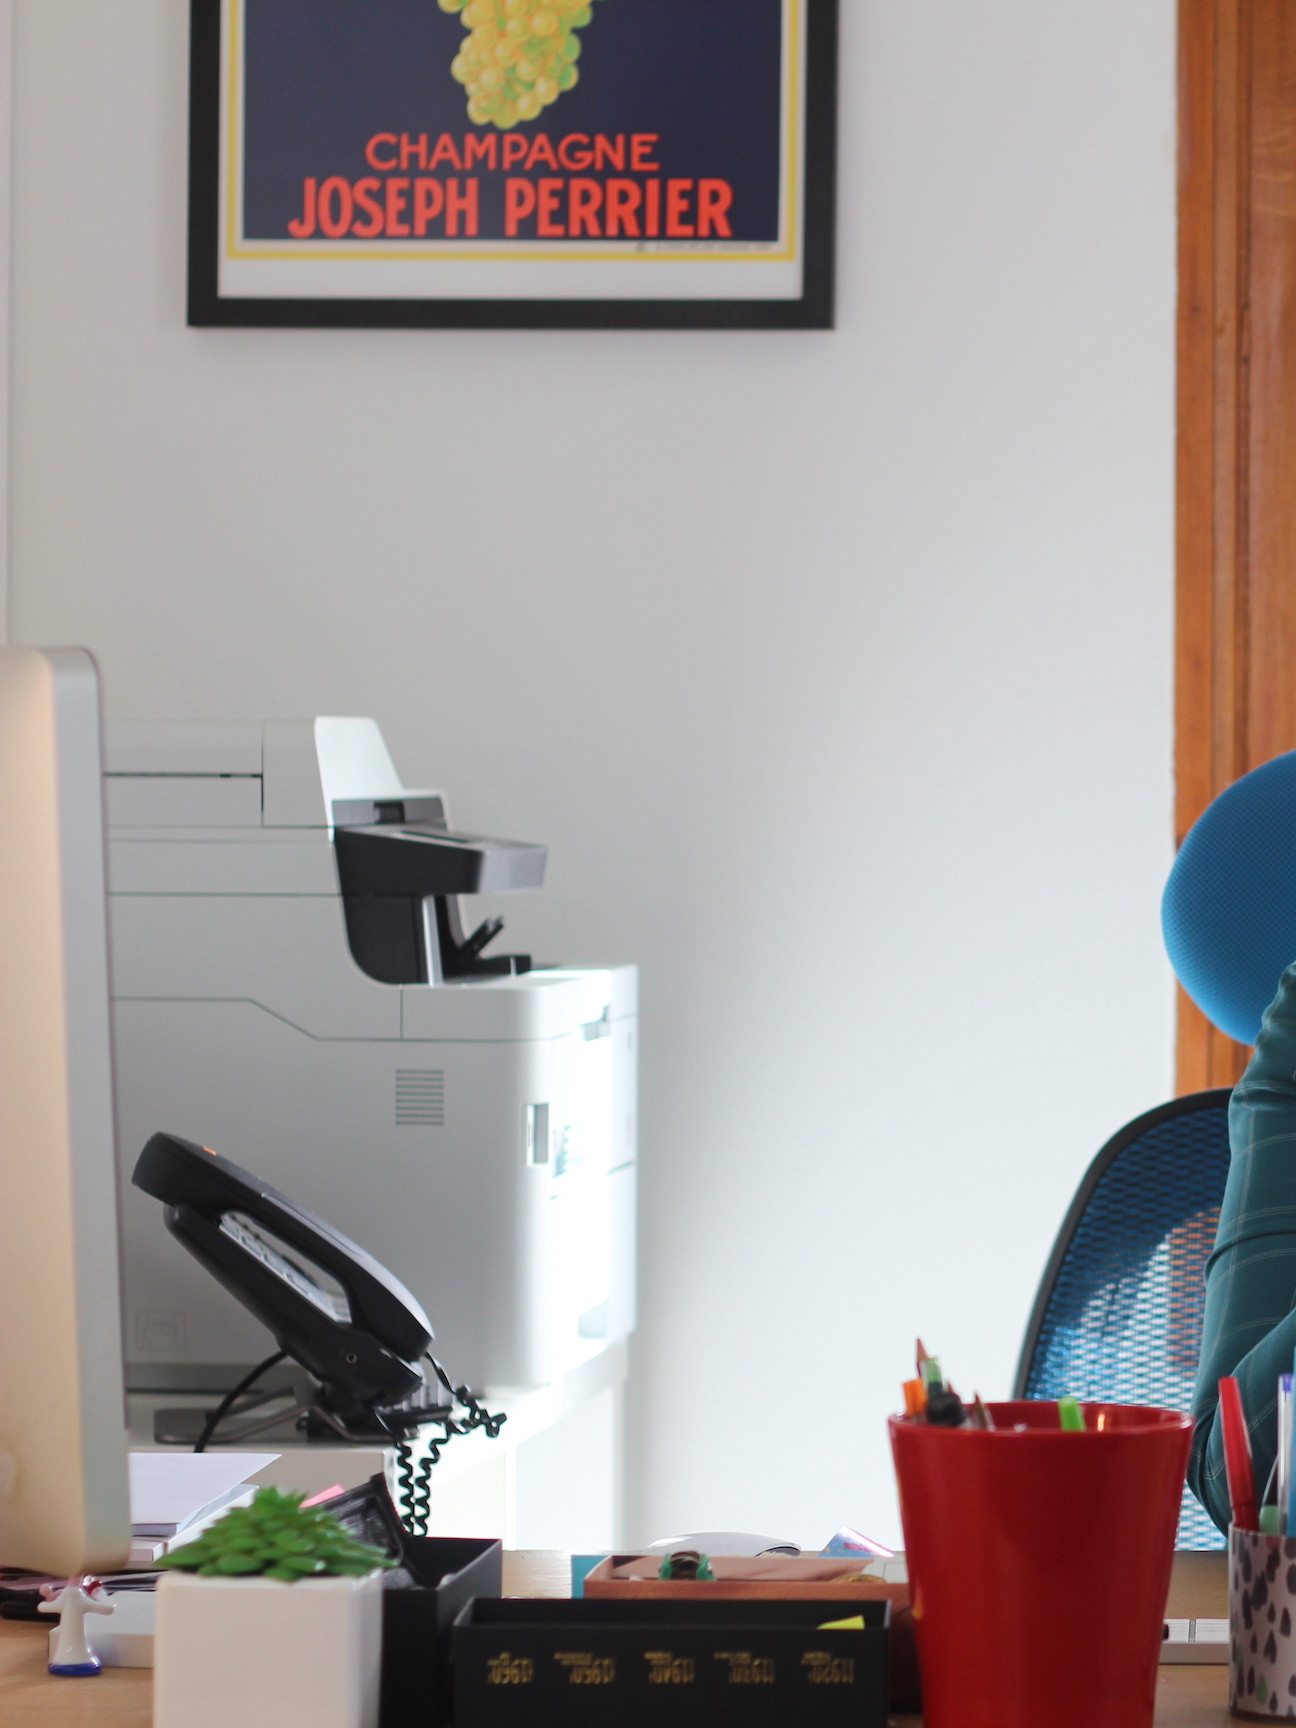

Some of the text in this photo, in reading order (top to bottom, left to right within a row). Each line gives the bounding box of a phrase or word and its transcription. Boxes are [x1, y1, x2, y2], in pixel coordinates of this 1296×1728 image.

[365, 132, 660, 172] CHAMPAGNE
[287, 176, 733, 239] JOSEPH PERRIER
